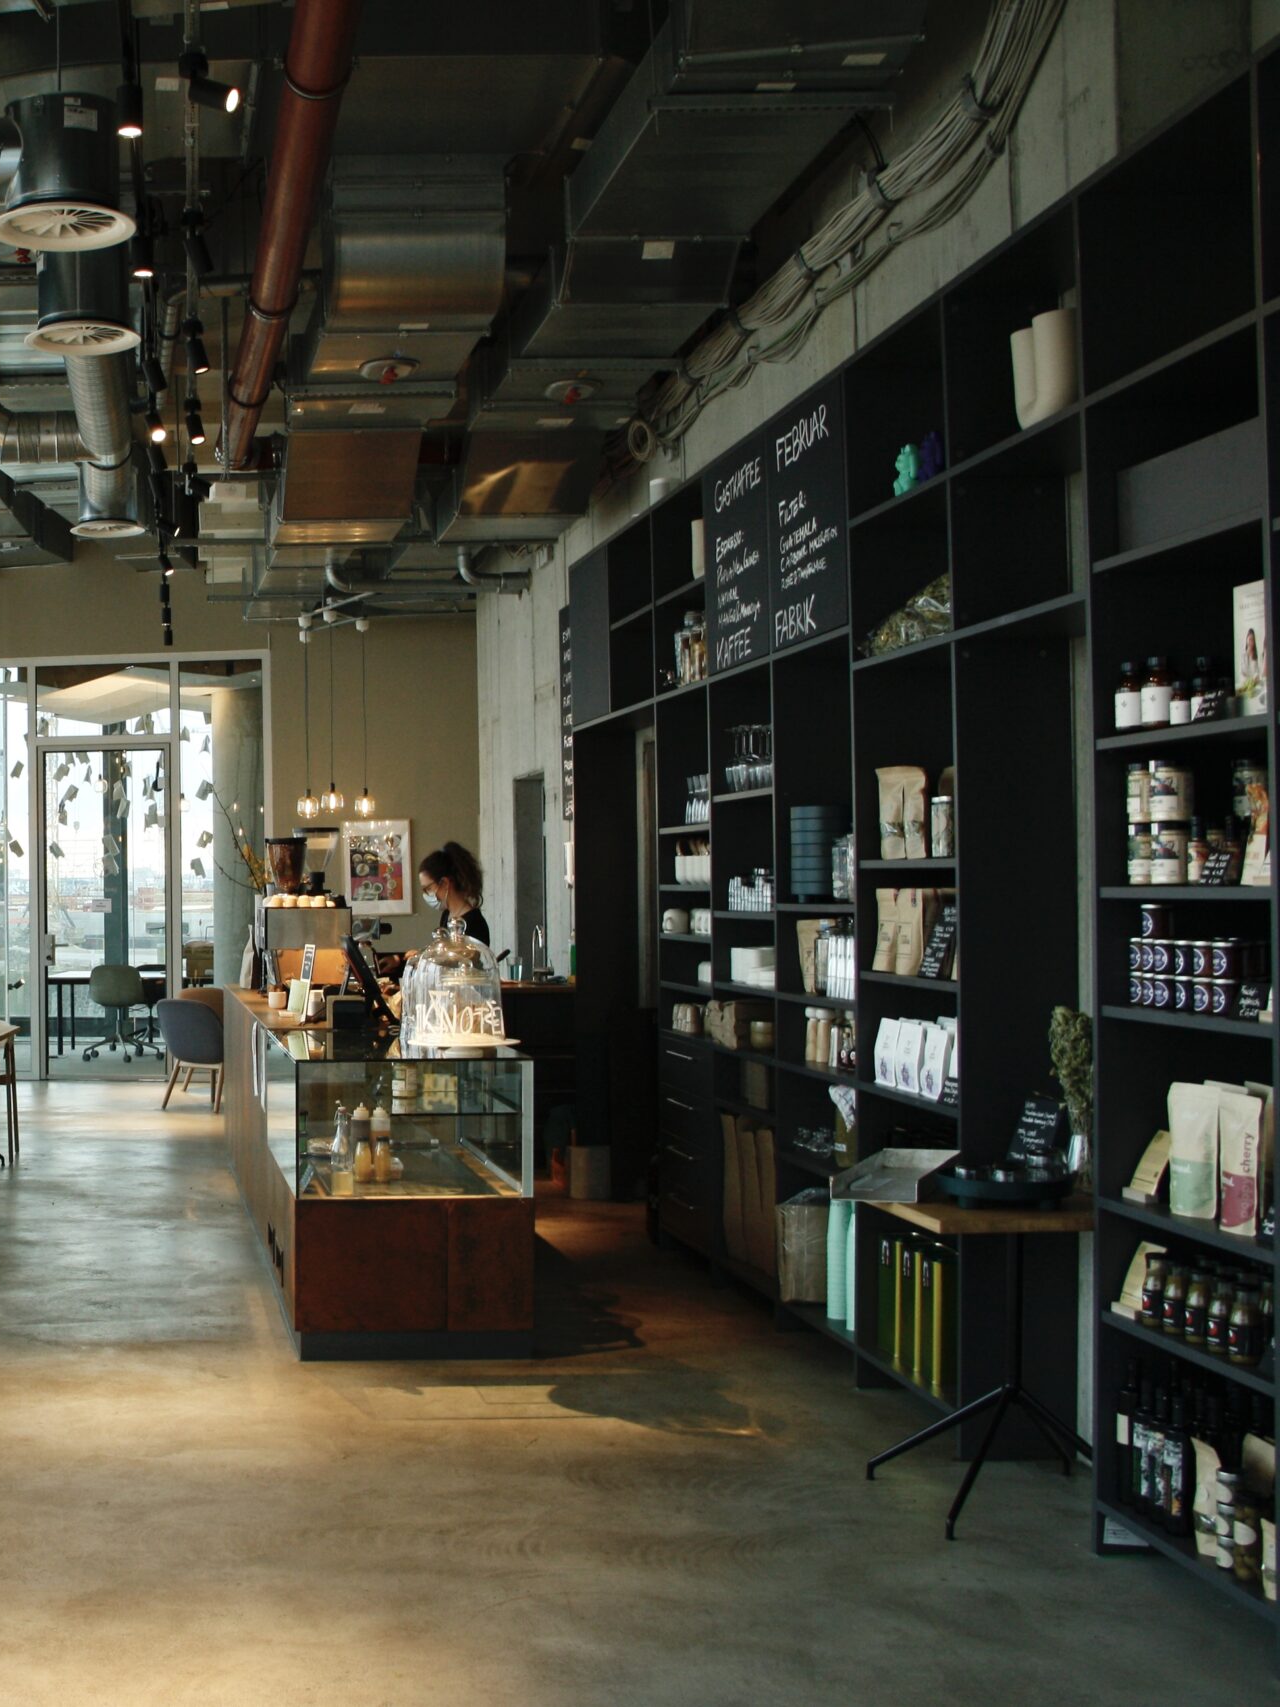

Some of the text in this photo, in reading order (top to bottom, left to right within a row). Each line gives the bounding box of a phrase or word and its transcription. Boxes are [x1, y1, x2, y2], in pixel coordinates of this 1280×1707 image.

[776, 403, 829, 473] FEBRUAR
[714, 456, 761, 513] GASTKAFFEE
[779, 516, 817, 554] GUATEMALA
[774, 592, 817, 648] FABRIK
[716, 626, 752, 671] KAFFEE
[1240, 1131, 1255, 1173] cherry
